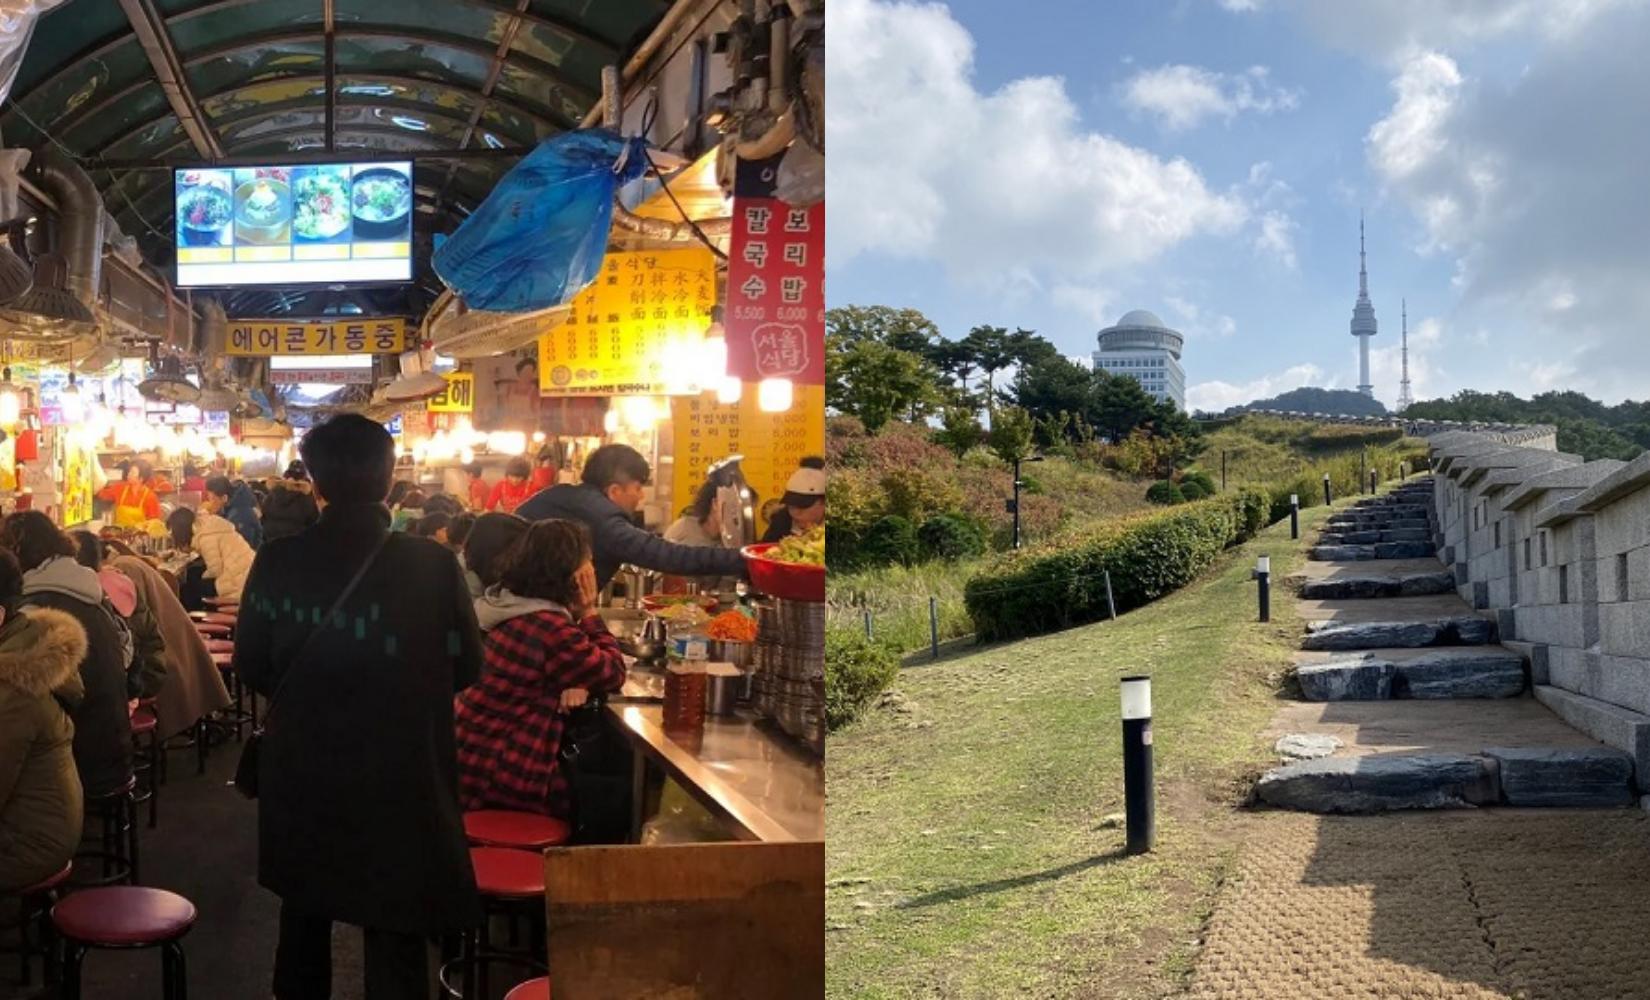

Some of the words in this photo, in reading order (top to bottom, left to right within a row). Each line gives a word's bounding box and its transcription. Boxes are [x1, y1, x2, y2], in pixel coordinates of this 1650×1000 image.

[741, 207, 772, 300] 칼국수
[780, 209, 811, 303] 보리밥
[734, 306, 765, 320] 5,500
[776, 307, 808, 320] 6,000
[232, 324, 396, 352] 에어콘가동중
[758, 329, 797, 348] 서울
[762, 348, 801, 369] 식당
